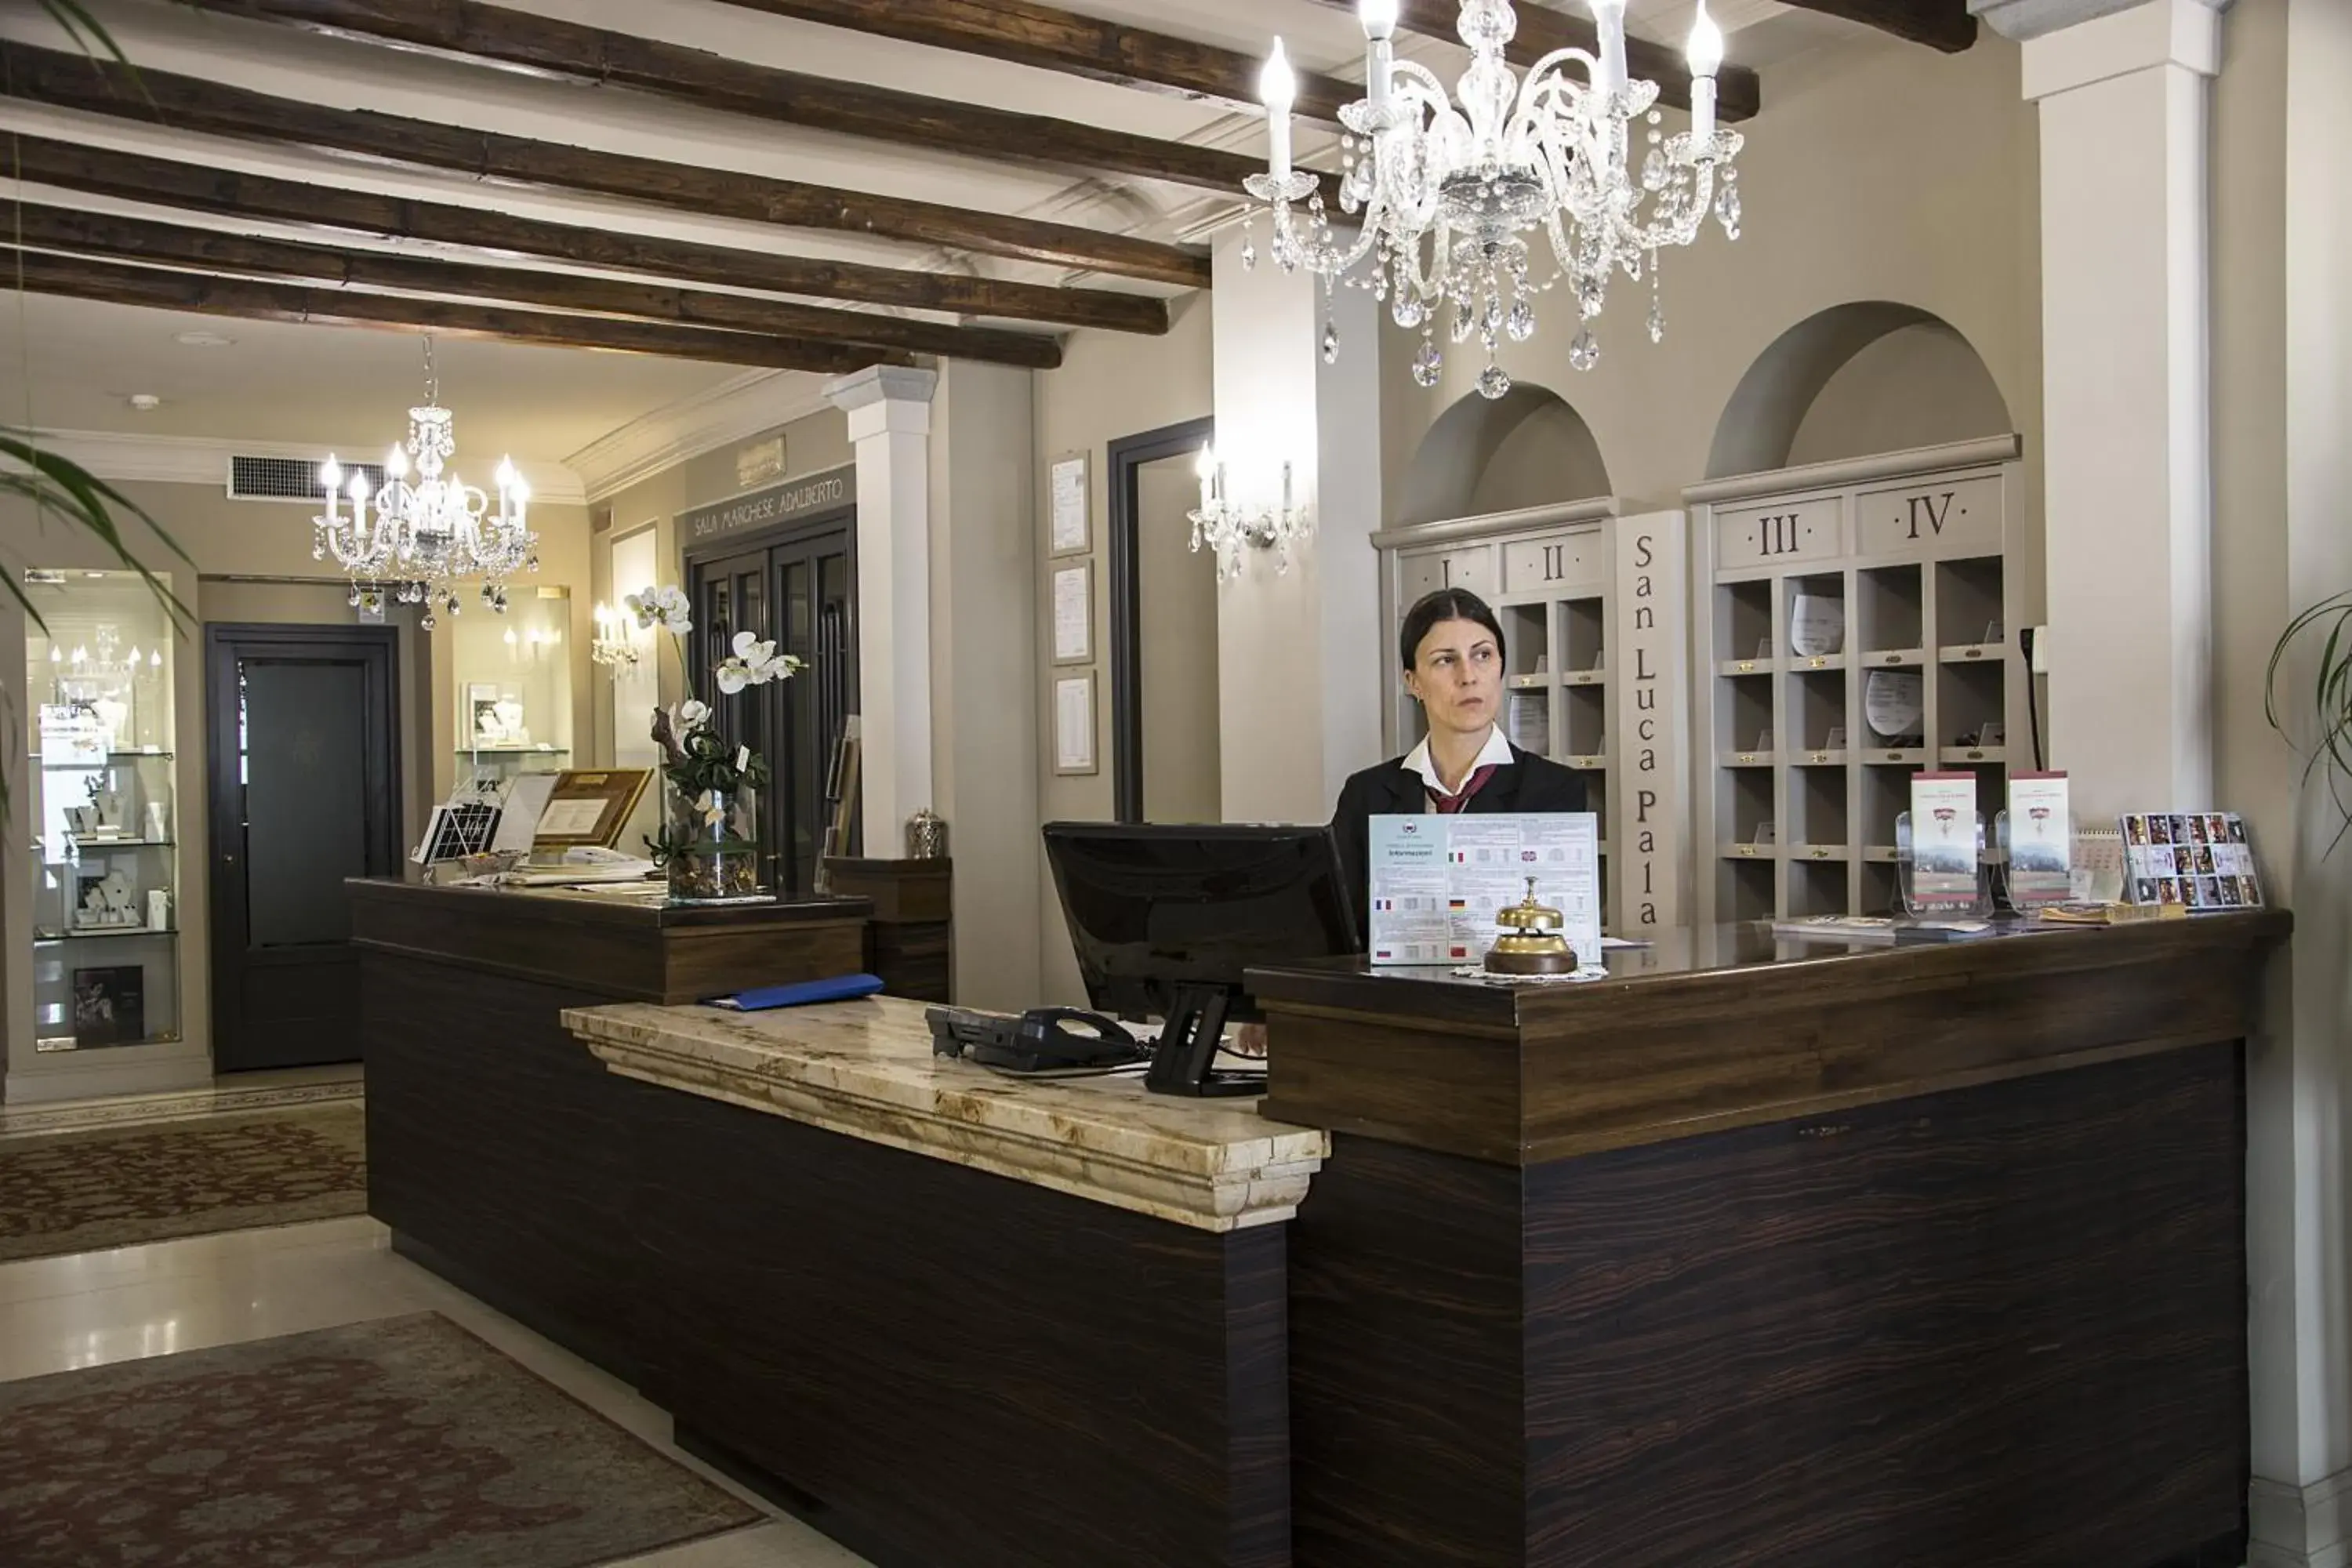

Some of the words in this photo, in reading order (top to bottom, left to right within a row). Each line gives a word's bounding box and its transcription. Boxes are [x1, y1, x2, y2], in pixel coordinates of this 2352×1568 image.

[694, 514, 718, 536] SALA
[721, 498, 775, 530] MARCHESE
[779, 478, 844, 514] ADALBERTO
[1635, 535, 1654, 630] San
[1635, 648, 1657, 771] Luca
